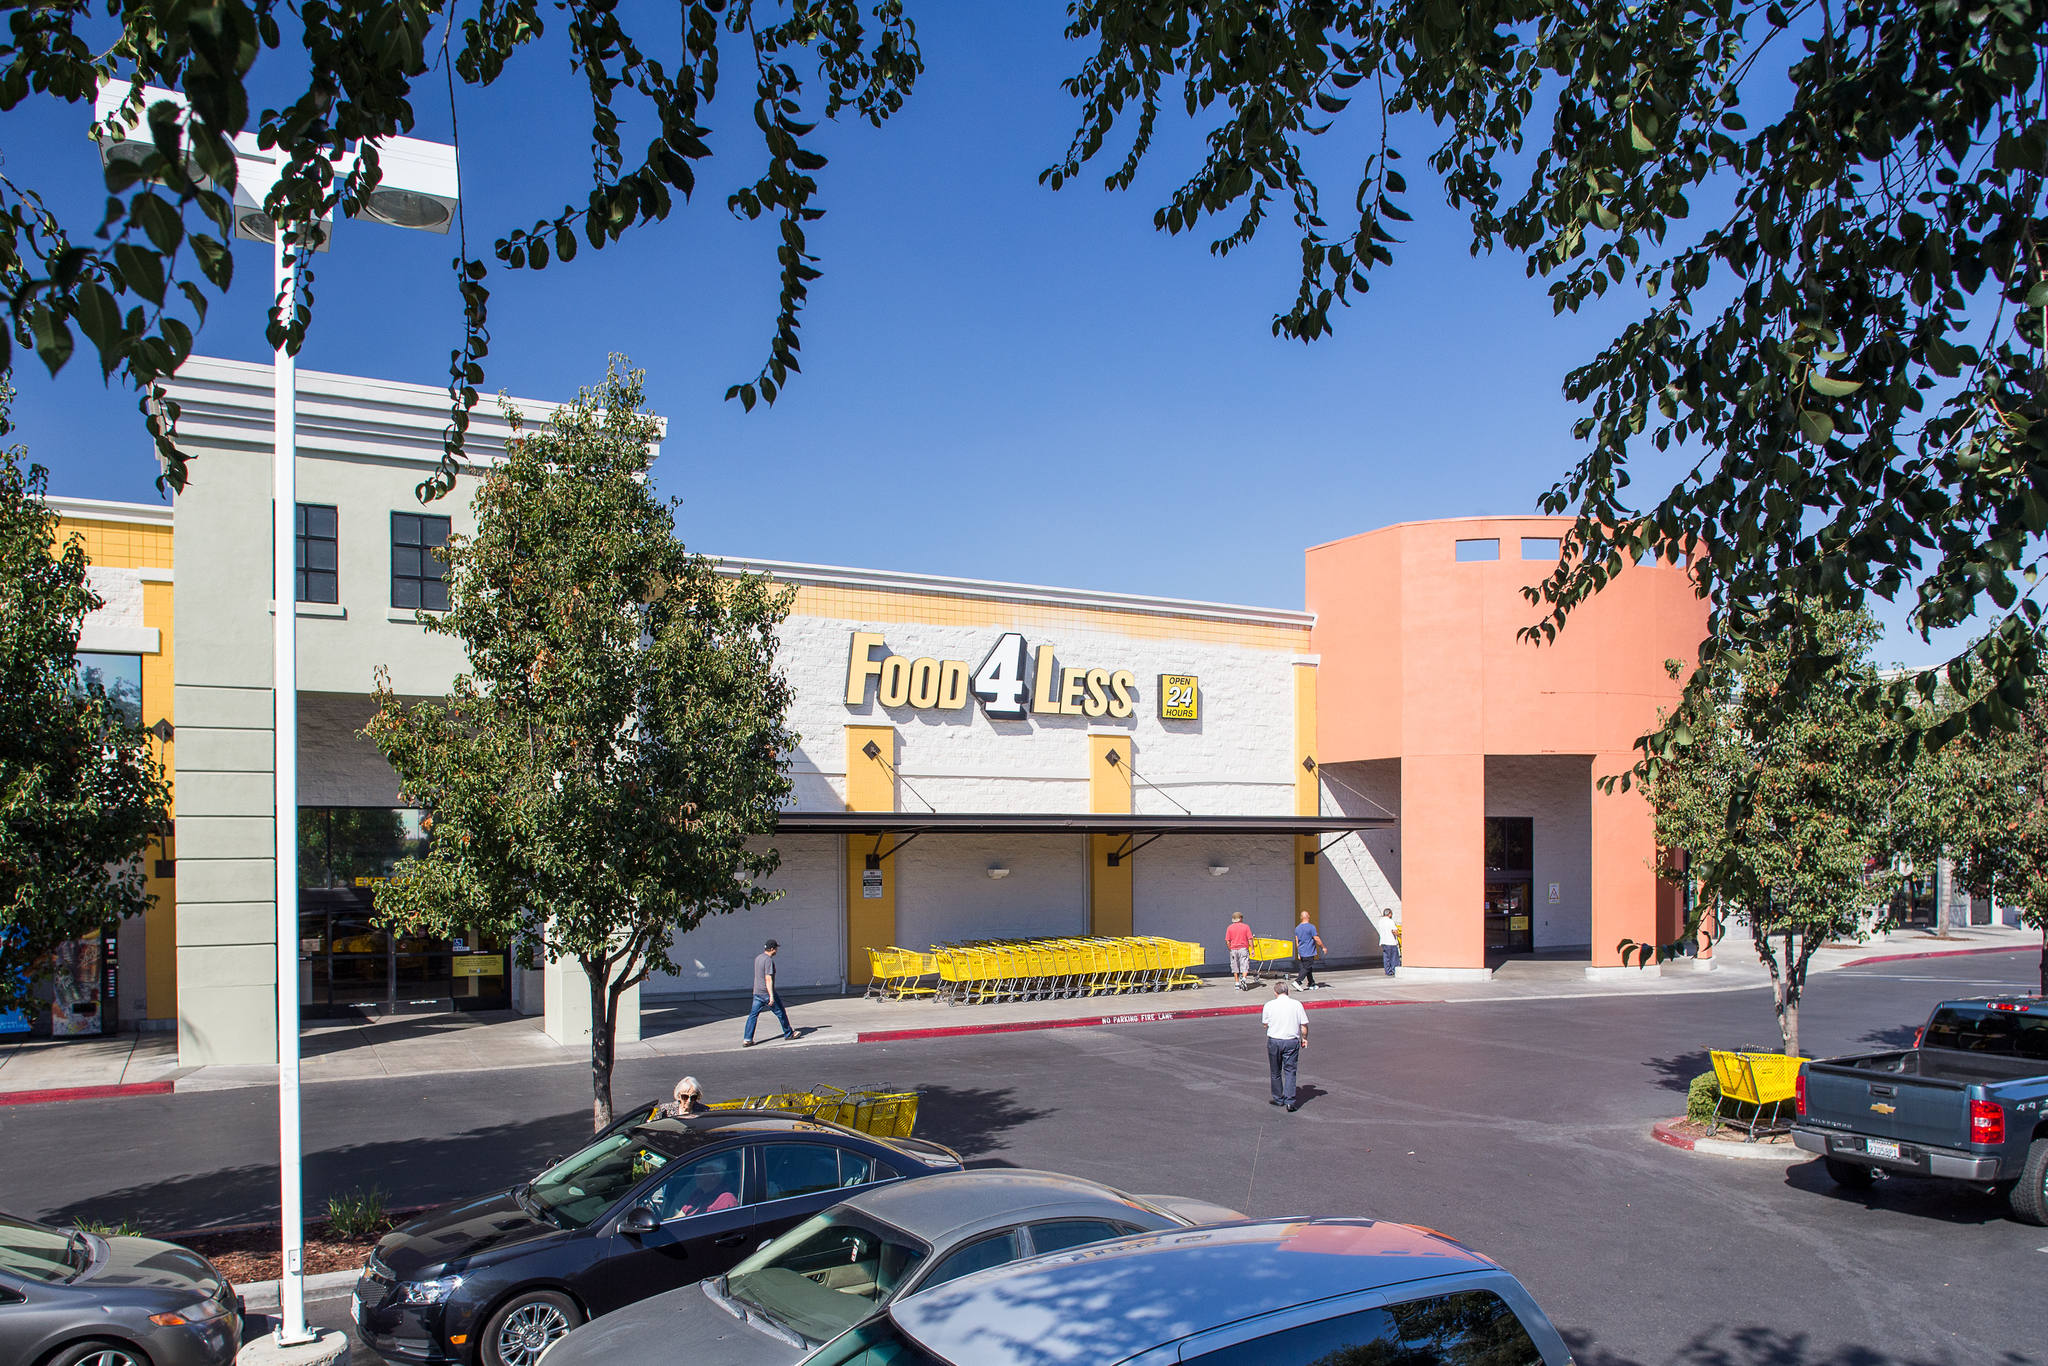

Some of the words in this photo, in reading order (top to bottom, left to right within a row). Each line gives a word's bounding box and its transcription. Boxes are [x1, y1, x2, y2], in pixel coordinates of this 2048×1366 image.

[845, 632, 970, 709] FOOD
[972, 633, 1028, 719] 4
[1031, 645, 1135, 718] LESS
[1169, 677, 1190, 685] OPEN
[1167, 686, 1193, 708] 24
[1166, 709, 1193, 717] HOURS
[1113, 1015, 1138, 1024] PARKING
[1141, 1014, 1156, 1022] FIRE
[1158, 1012, 1173, 1020] LANE
